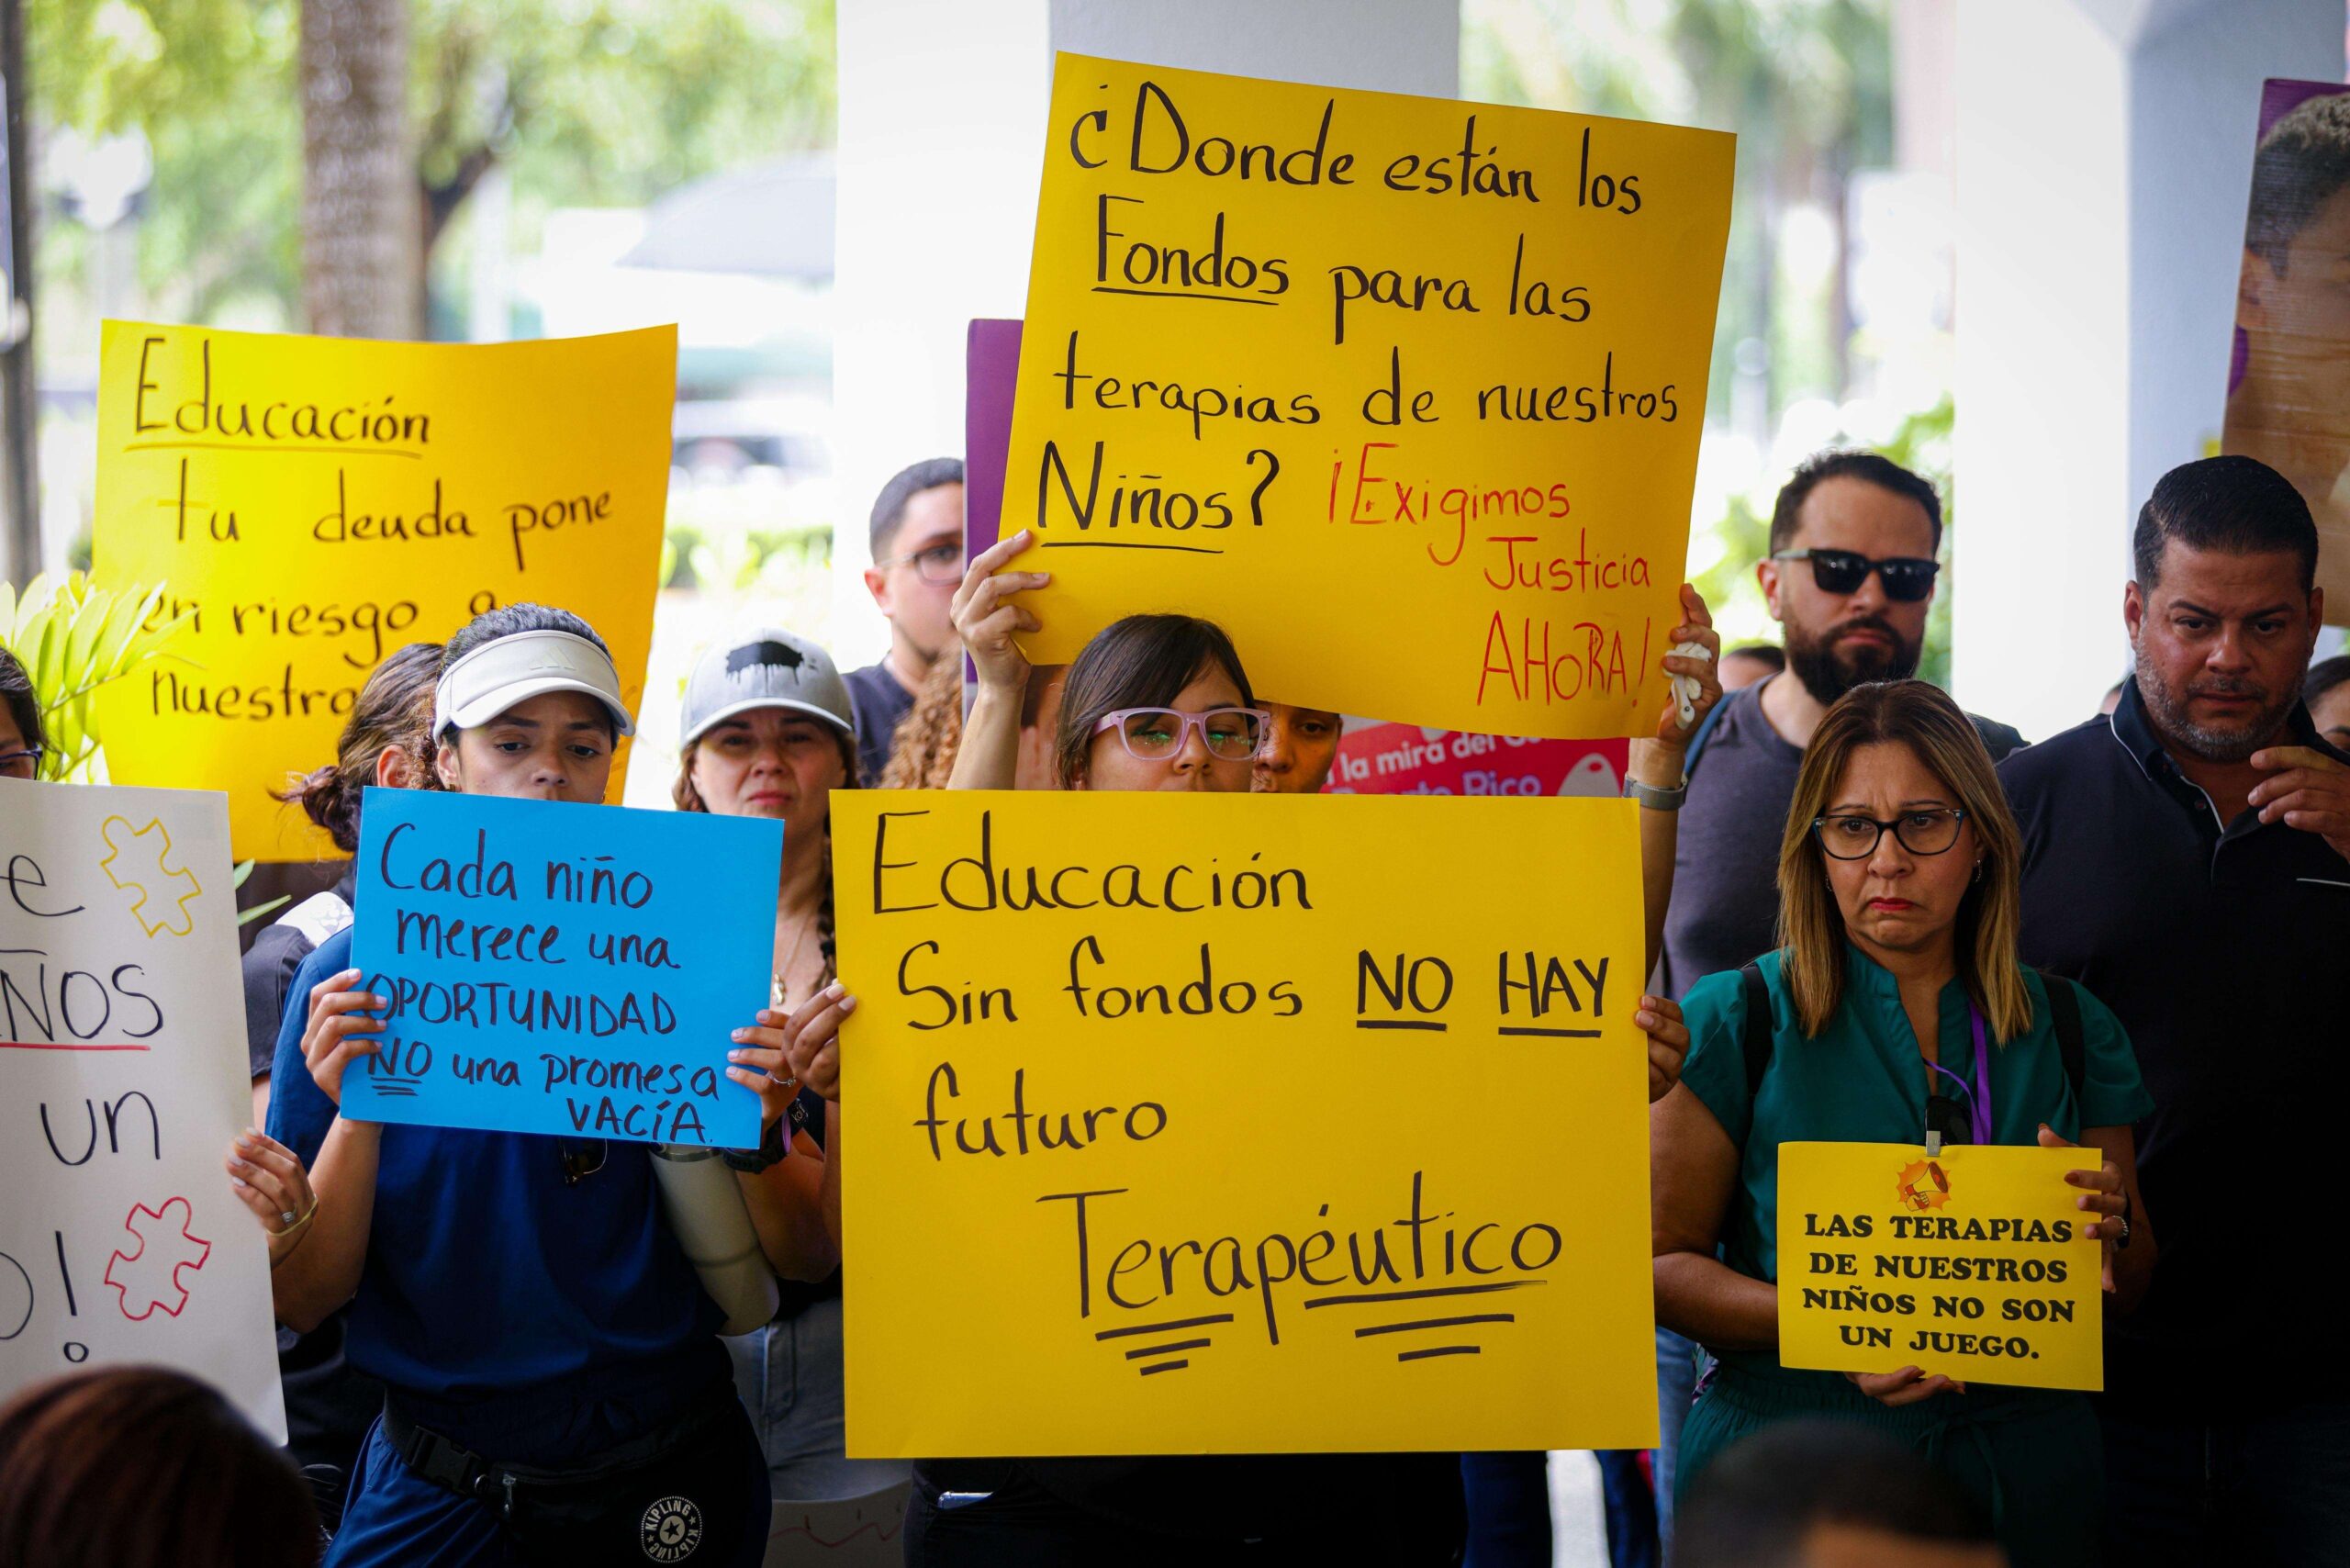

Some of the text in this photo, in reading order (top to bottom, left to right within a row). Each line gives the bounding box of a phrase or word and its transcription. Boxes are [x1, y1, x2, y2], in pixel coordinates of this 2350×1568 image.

[1384, 115, 1539, 203] están
[1579, 128, 1640, 214] los
[1098, 194, 1590, 345] Fondos para las
[135, 337, 431, 444] Educación
[1054, 330, 1677, 440] terapias de nuestros
[158, 459, 612, 572] tu deuda pone
[1038, 441, 1570, 566] Niños? ¡Exigimos
[1484, 527, 1651, 593] Justicia
[138, 588, 201, 635] en
[232, 595, 419, 669] riesgo
[1339, 752, 1371, 782] la
[1376, 740, 1447, 776] mira
[1451, 732, 1497, 759] del
[1462, 769, 1542, 796] Rico
[382, 823, 652, 908] Cada niño
[874, 811, 1312, 913] Educación
[397, 910, 679, 969] merece una
[365, 974, 677, 1036] OPORTUNIDAD
[899, 935, 1608, 1030] Sin fondos NO HAY
[368, 1037, 719, 1100] NO una promesa
[914, 1062, 1167, 1160] futuro
[1036, 1170, 1562, 1345] Terapéutico
[1806, 1214, 2072, 1242] LAS TERAPIAS
[1803, 1285, 2075, 1322] NIÑOS NO SON
[1809, 1253, 2066, 1282] DE NUESTROS
[1840, 1326, 2039, 1359] UN JUEGO.
[645, 1500, 691, 1531] KIPLING
[649, 1529, 698, 1560] KIPLING
